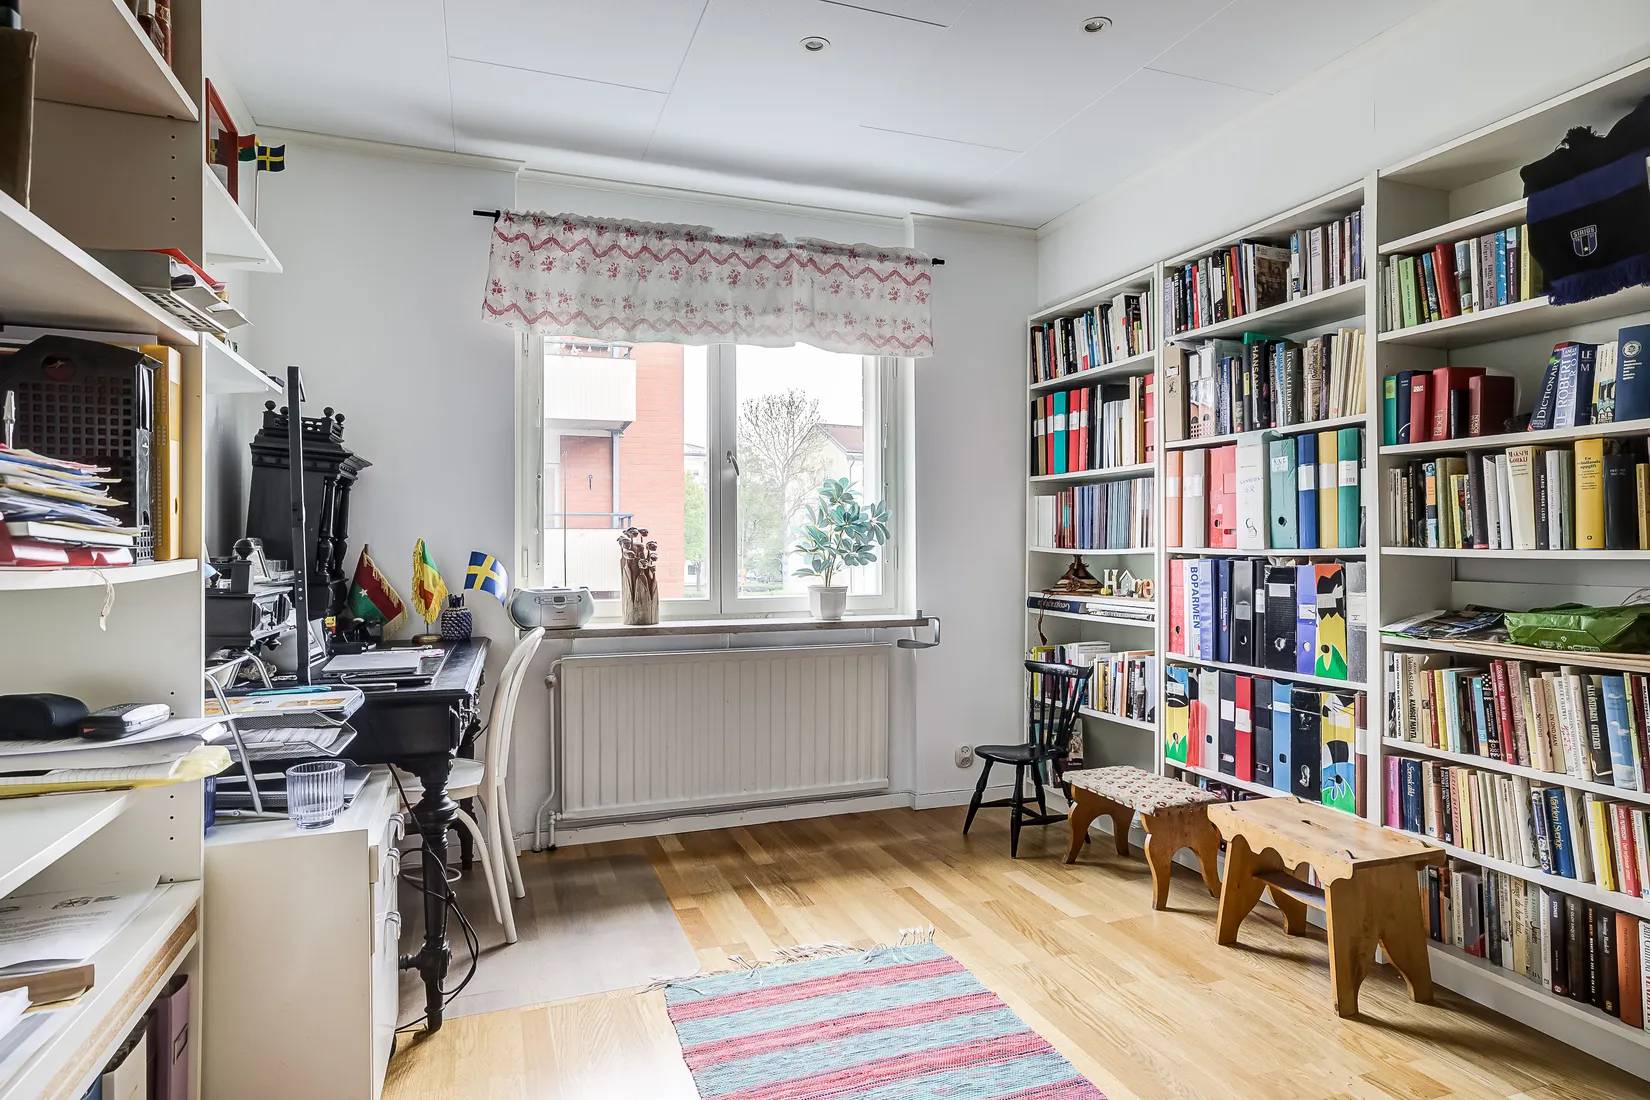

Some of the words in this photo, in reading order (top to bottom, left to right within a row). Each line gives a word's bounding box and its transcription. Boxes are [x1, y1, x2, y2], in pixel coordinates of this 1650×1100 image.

[1573, 226, 1594, 238] SIRIUS
[1537, 358, 1561, 419] DICTIONARY
[1557, 359, 1572, 408] ROBERT
[1567, 358, 1577, 406] MICRO
[1434, 409, 1444, 436] Bibeln
[1555, 412, 1567, 426] LE
[1496, 664, 1504, 679] GÖRAN
[1586, 684, 1595, 697] KLAS
[1588, 697, 1598, 722] ÖSTERGREN
[1591, 724, 1601, 750] GENTLEMEN
[1406, 762, 1415, 785] Svensk
[1407, 785, 1416, 797] dikt
[1550, 796, 1561, 821] Världen
[1552, 824, 1564, 850] Sverige
[1515, 898, 1524, 907] du
[1515, 908, 1524, 920] har
[1530, 921, 1541, 944] Synden
